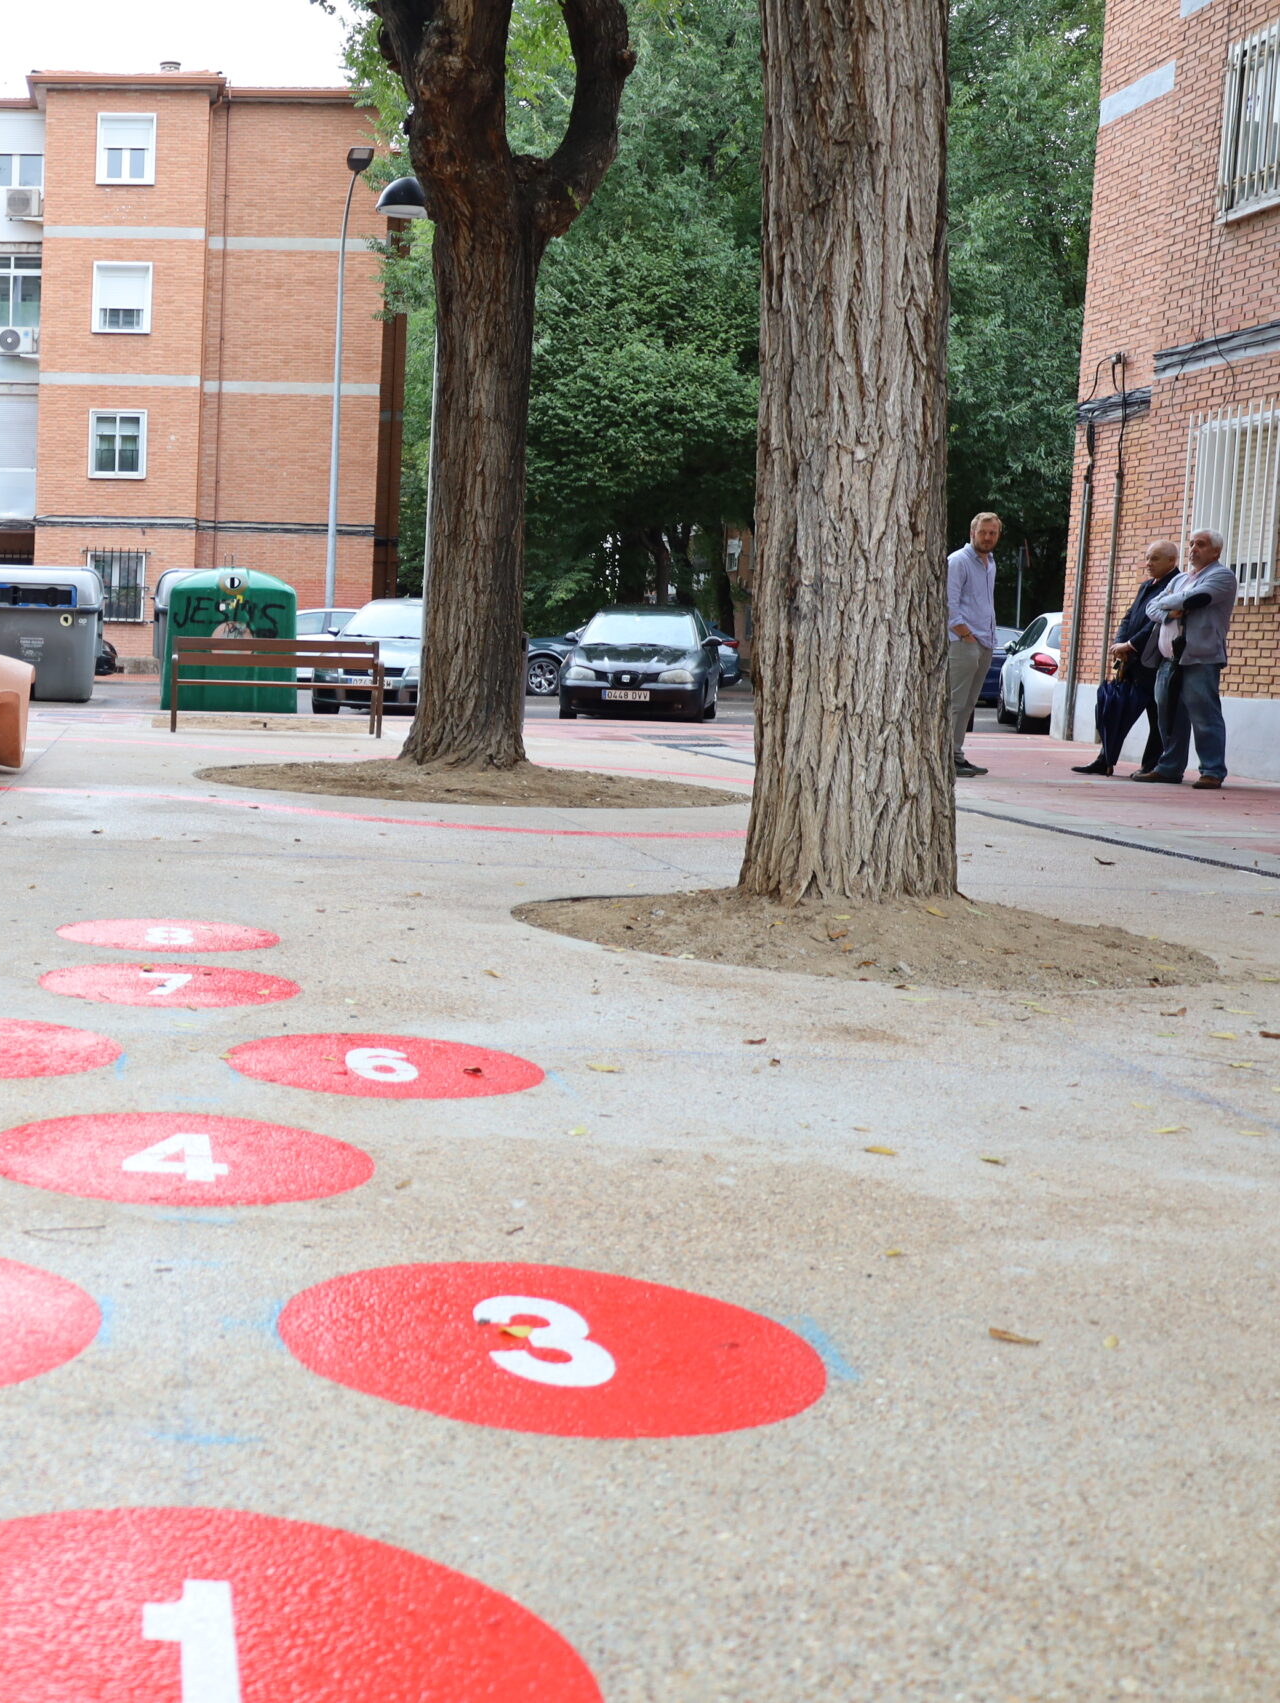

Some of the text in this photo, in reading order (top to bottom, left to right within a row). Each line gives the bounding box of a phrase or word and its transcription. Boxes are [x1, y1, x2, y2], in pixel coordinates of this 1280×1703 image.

[607, 691, 629, 699] 0448
[144, 926, 194, 946] 8
[139, 971, 194, 996] 7
[344, 1047, 419, 1083] 6
[121, 1132, 230, 1182] 4
[472, 1295, 616, 1387] 3
[140, 1578, 242, 1703] 1
